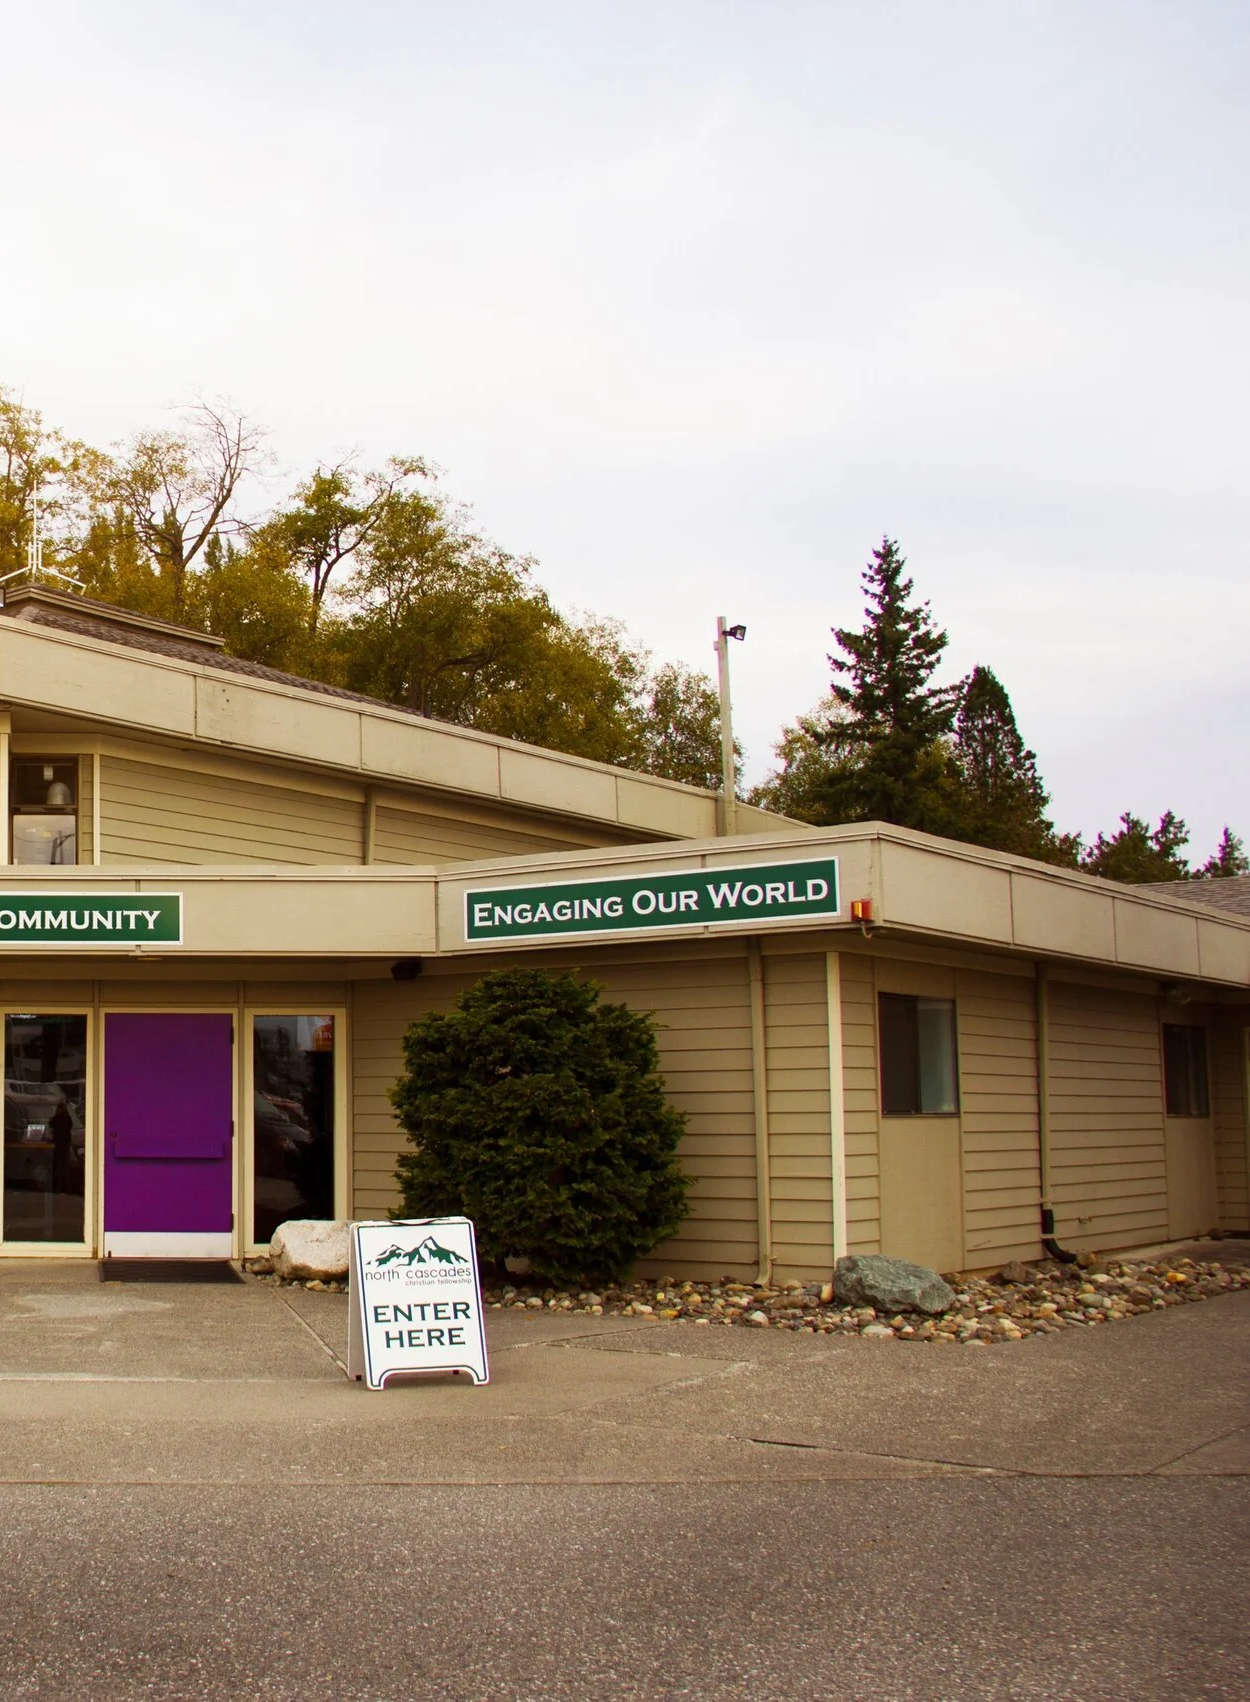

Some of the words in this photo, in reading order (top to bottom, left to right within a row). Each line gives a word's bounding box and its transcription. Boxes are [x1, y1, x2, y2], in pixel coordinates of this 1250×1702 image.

[472, 896, 623, 928] ENGAGING
[631, 889, 700, 916] OUR
[706, 878, 829, 909] WORLD
[365, 1268, 400, 1282] north
[406, 1266, 472, 1279] cascades
[373, 1301, 471, 1324] ENTER
[385, 1327, 466, 1348] HERE
